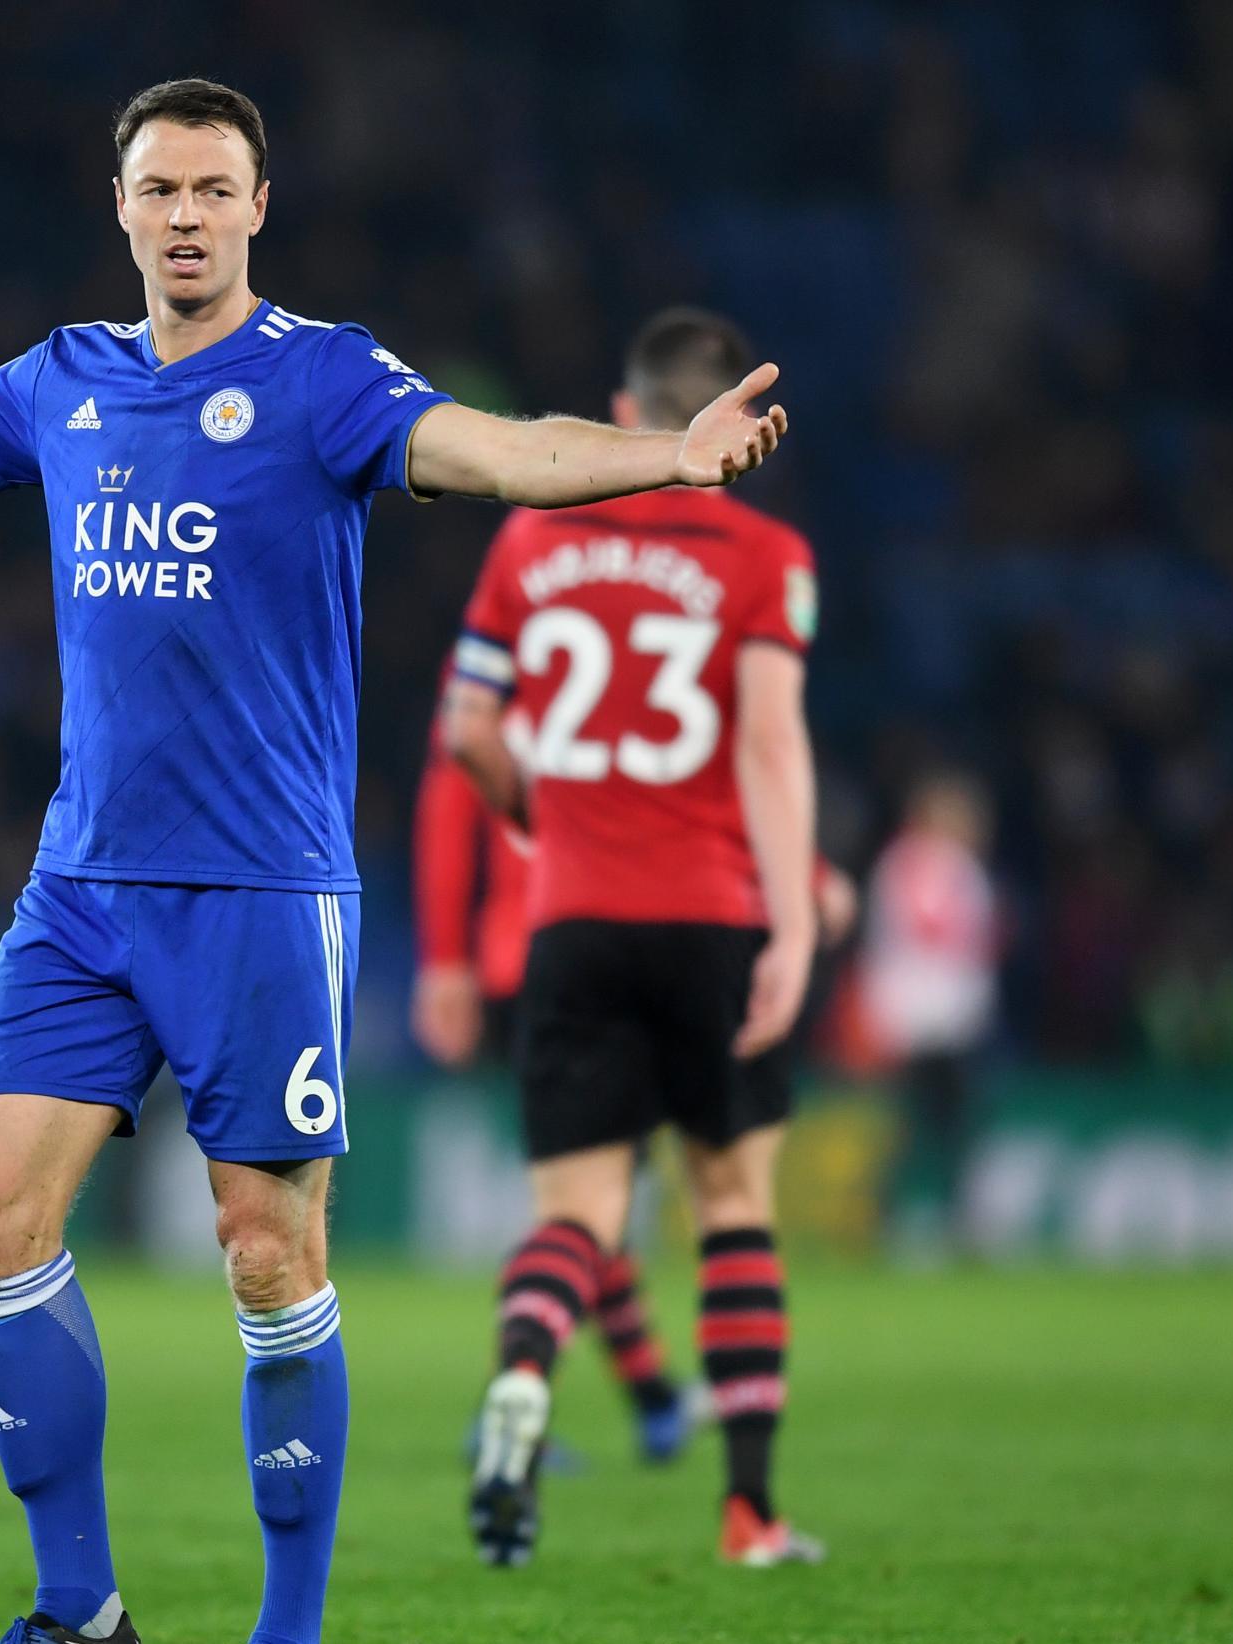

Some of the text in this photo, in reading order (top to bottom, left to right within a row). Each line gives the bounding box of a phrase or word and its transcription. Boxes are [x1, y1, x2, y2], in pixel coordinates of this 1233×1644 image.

[66, 418, 103, 430] adidas
[73, 502, 218, 554] KING
[73, 560, 213, 600] POWER
[509, 607, 720, 784] 23
[284, 1046, 338, 1136] 6
[253, 1455, 322, 1470] adidas
